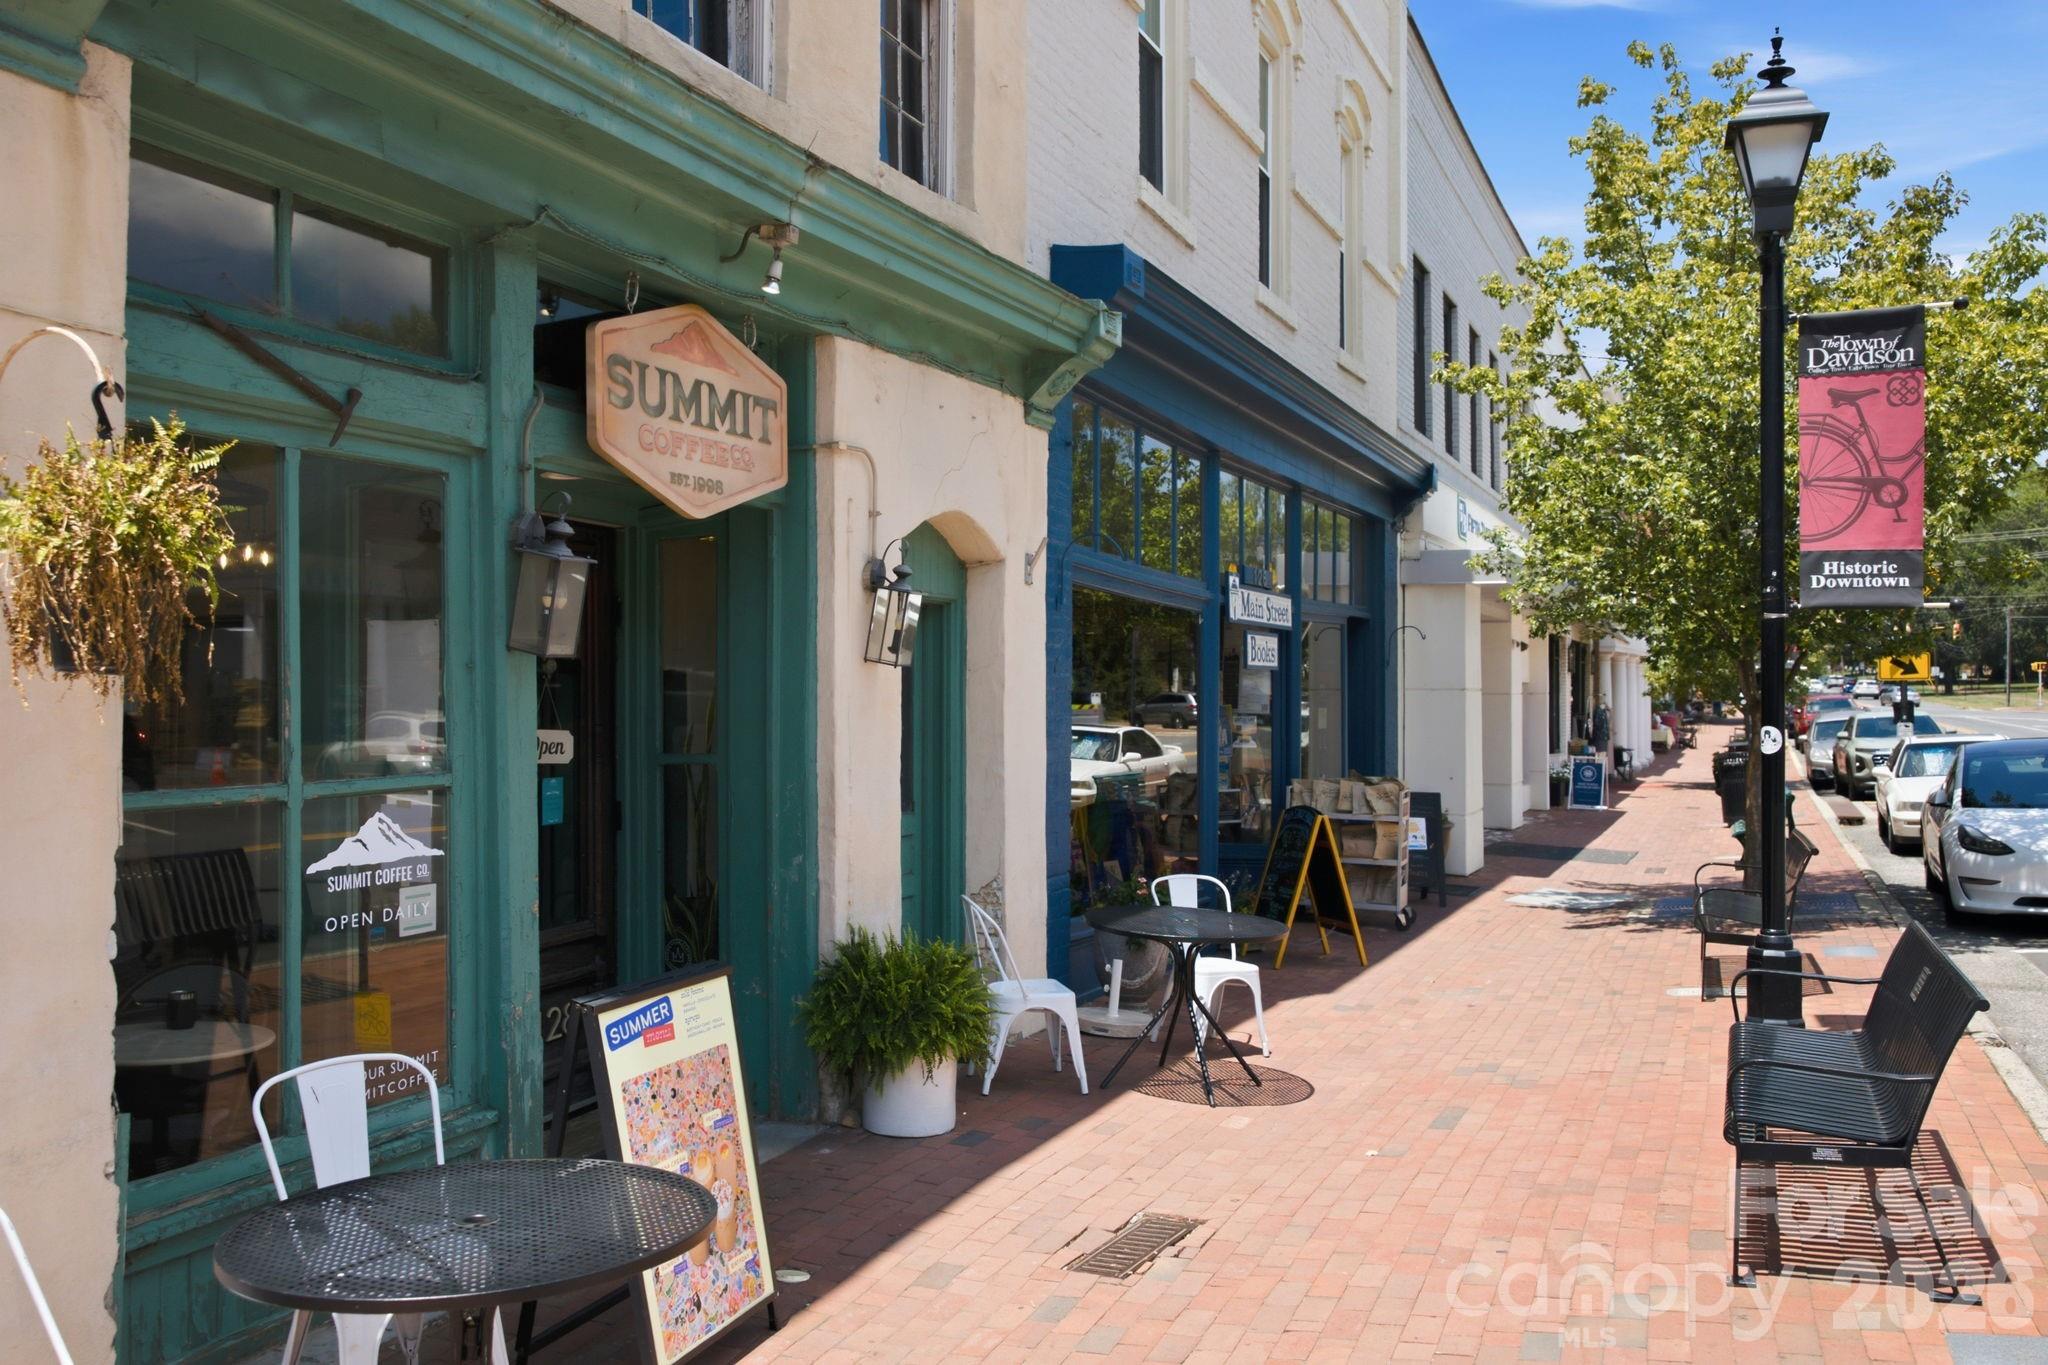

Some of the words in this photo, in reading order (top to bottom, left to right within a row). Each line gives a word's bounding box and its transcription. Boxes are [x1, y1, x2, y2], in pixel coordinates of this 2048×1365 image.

[1820, 338, 1840, 349] The
[1833, 335, 1883, 352] Town
[1882, 334, 1903, 353] of
[1806, 345, 1916, 369] Davidson
[606, 353, 778, 446] SUMMIT
[638, 423, 729, 468] COFFEE
[669, 472, 691, 486] EST.
[692, 475, 724, 496] 1998
[1822, 560, 1898, 575] Historic
[1810, 575, 1910, 589] Downtown
[1241, 590, 1264, 619] Main
[1266, 596, 1289, 623] Street
[1250, 636, 1276, 663] Books
[537, 736, 565, 759] pen
[327, 870, 373, 893] SUMMIT
[375, 865, 413, 886] COFFEE
[416, 863, 430, 877] CO.
[325, 910, 373, 932] OPEN
[382, 901, 430, 923] DAILY
[609, 1002, 670, 1045] SUMMER
[390, 1050, 439, 1074] SUMIT
